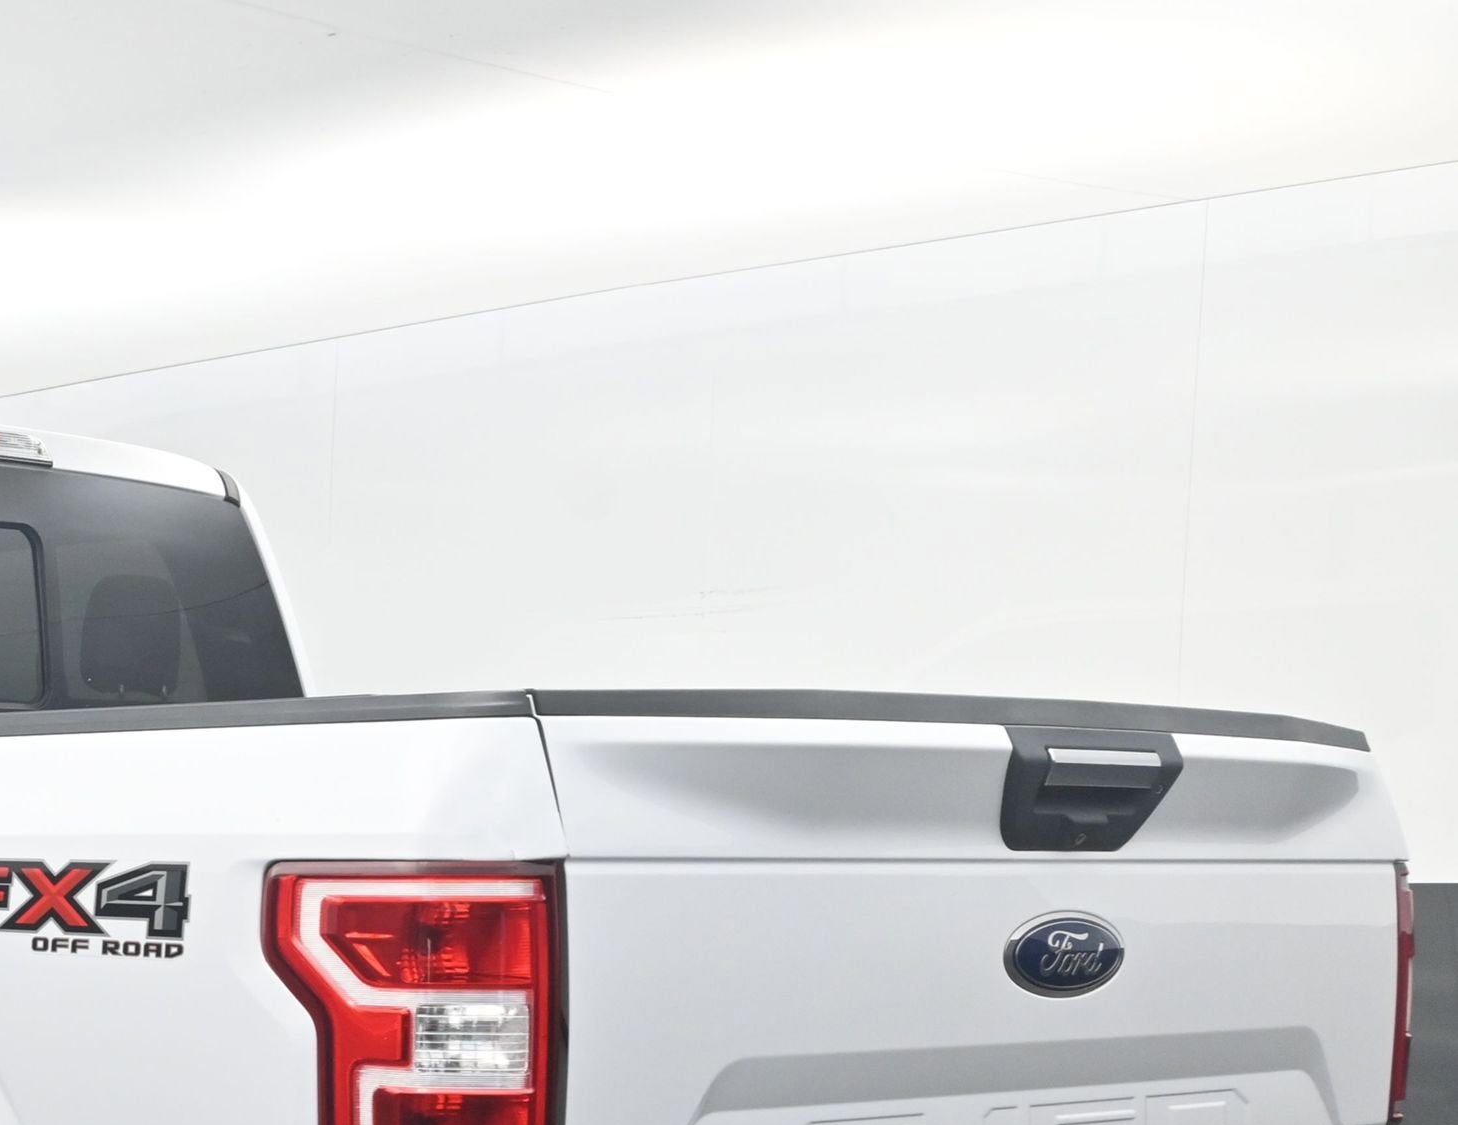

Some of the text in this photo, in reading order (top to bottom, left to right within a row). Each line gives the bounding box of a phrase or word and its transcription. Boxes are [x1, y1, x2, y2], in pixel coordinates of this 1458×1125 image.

[31, 936, 185, 959] OFF ROAD
[1039, 930, 1104, 977] Ford
